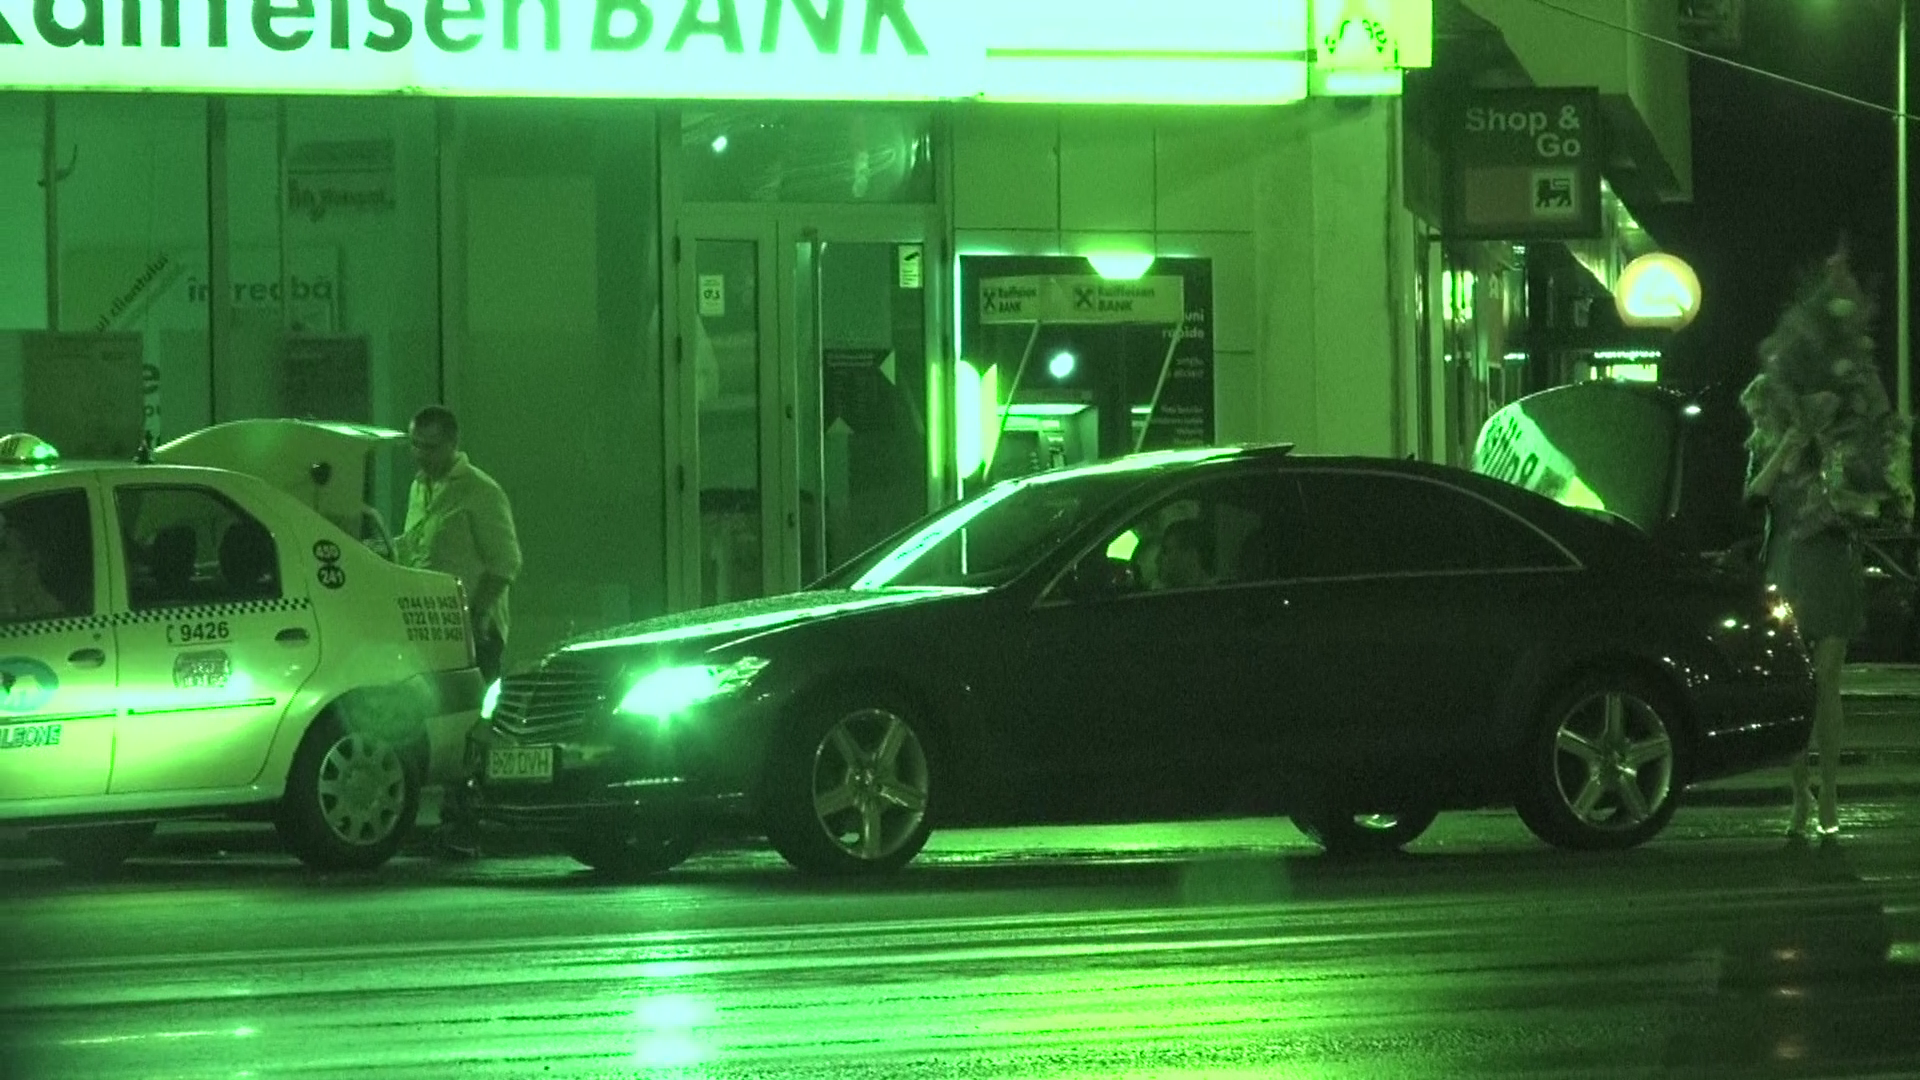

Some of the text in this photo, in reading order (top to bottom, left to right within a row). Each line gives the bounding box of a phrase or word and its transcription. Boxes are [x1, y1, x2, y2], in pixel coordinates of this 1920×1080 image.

[0, 0, 557, 52] aesen
[1465, 104, 1580, 137] Shop &
[1536, 132, 1581, 157] Go
[1098, 300, 1133, 312] BANK
[180, 621, 230, 642] 9426
[0, 726, 61, 749] LEONE
